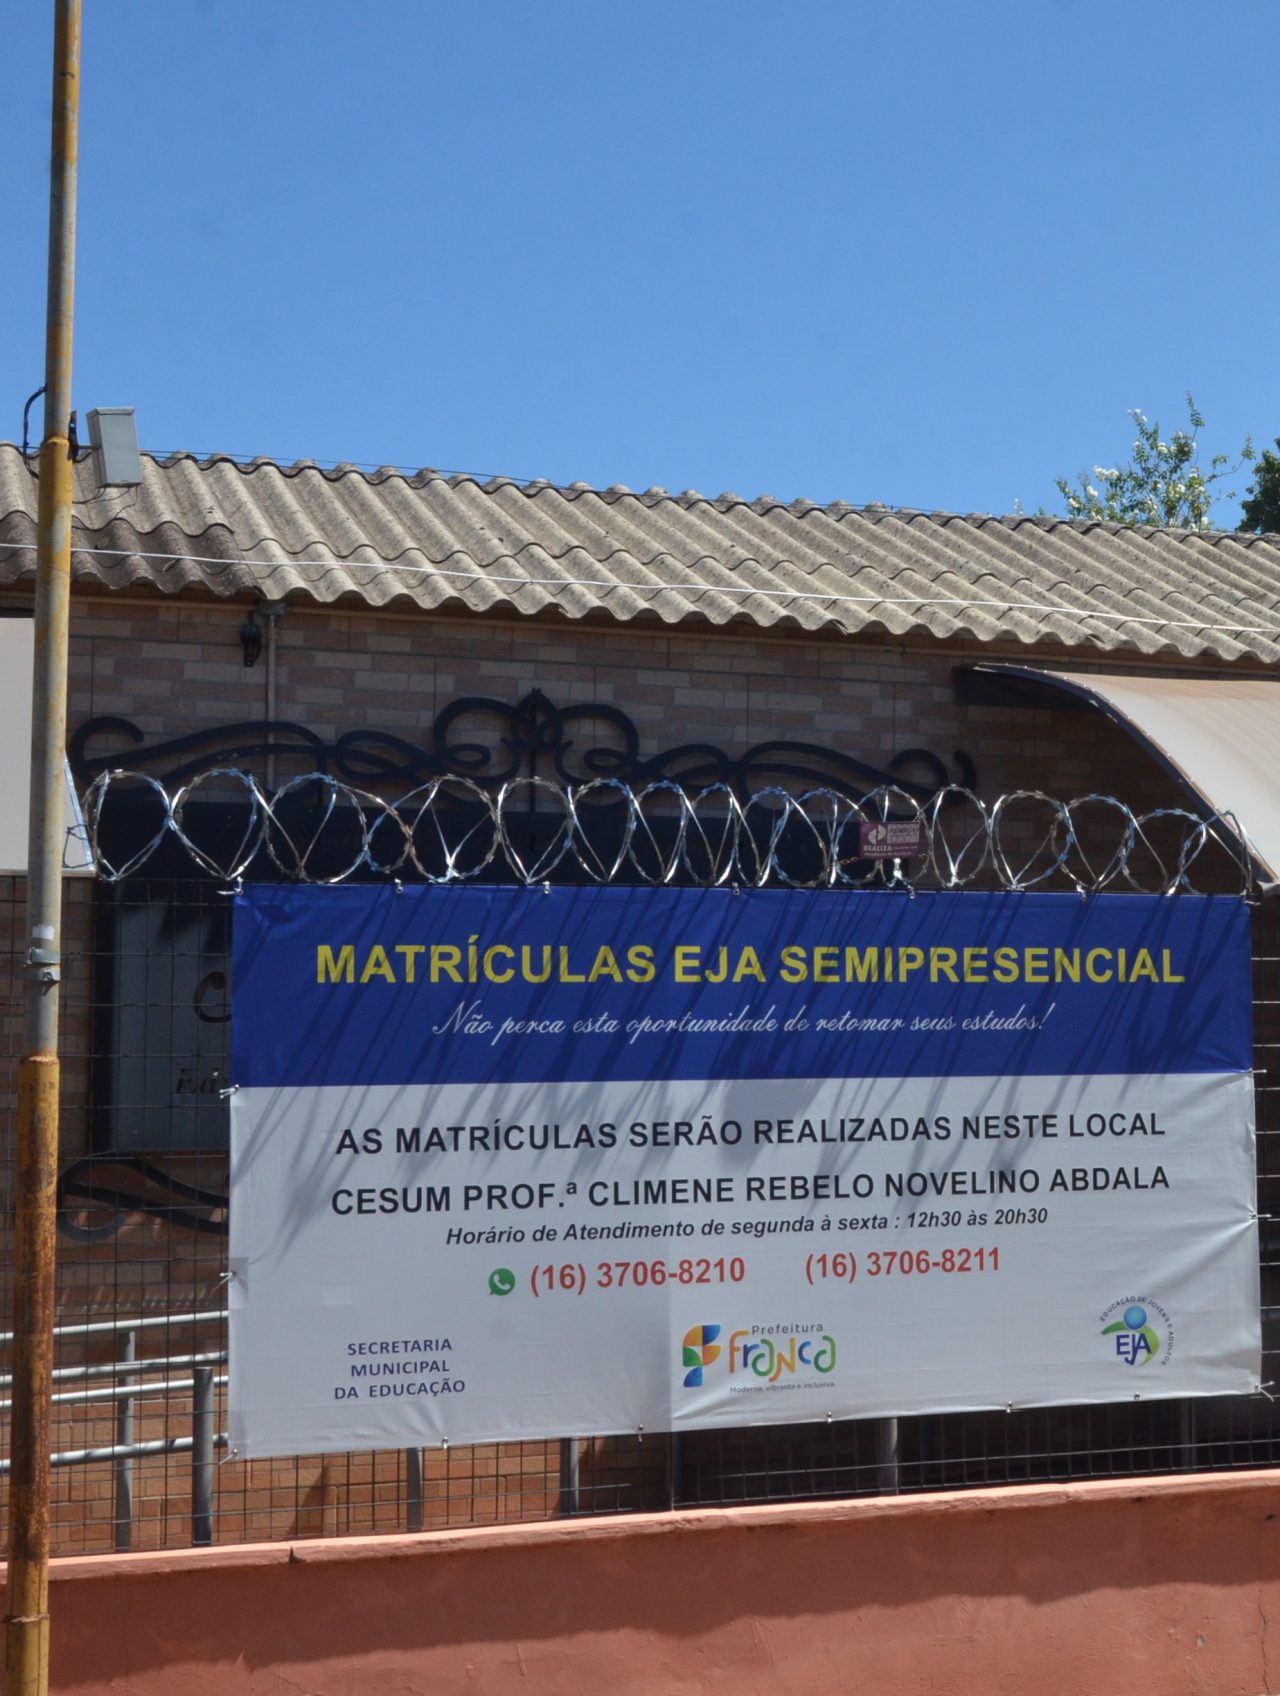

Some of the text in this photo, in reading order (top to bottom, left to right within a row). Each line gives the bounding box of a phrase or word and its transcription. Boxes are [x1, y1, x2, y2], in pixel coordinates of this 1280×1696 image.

[316, 934, 1186, 984] MATRÍCULAS EJA SEMIPRESENCIAL
[432, 999, 1056, 1046] Não perca esta oportunidade de retomar seus estudos!
[335, 1112, 1166, 1155] AS MATRÍCULAS SERÃO REALIZADAS NESTE LOCAL
[331, 1186, 451, 1216] CESUM
[588, 1178, 735, 1207] CLIMENE
[745, 1172, 875, 1201] REBELO
[884, 1168, 1041, 1198] NOVELINO
[1049, 1165, 1170, 1193] ABDALA
[446, 1226, 526, 1245] Horário
[532, 1224, 558, 1242] de
[563, 1221, 695, 1241] Atendimento
[700, 1219, 726, 1236] de
[732, 1214, 815, 1239] segunda
[821, 1213, 833, 1232] à
[837, 1214, 889, 1231] sexta
[907, 1211, 962, 1229] 12h30
[966, 1208, 988, 1227] às
[994, 1207, 1048, 1225] 20h30
[530, 1256, 746, 1298] (16) 3706-8210
[805, 1246, 1001, 1285] (16) 3706-8211
[1100, 1295, 1136, 1323] EDUCAÇÃO
[347, 1338, 453, 1357] SECRETARIA
[751, 1322, 824, 1336] Prefeitura
[1116, 1332, 1152, 1366] EJA
[350, 1360, 450, 1377] MUNICIPAL
[334, 1378, 466, 1400] DA EDUCAÇÃO
